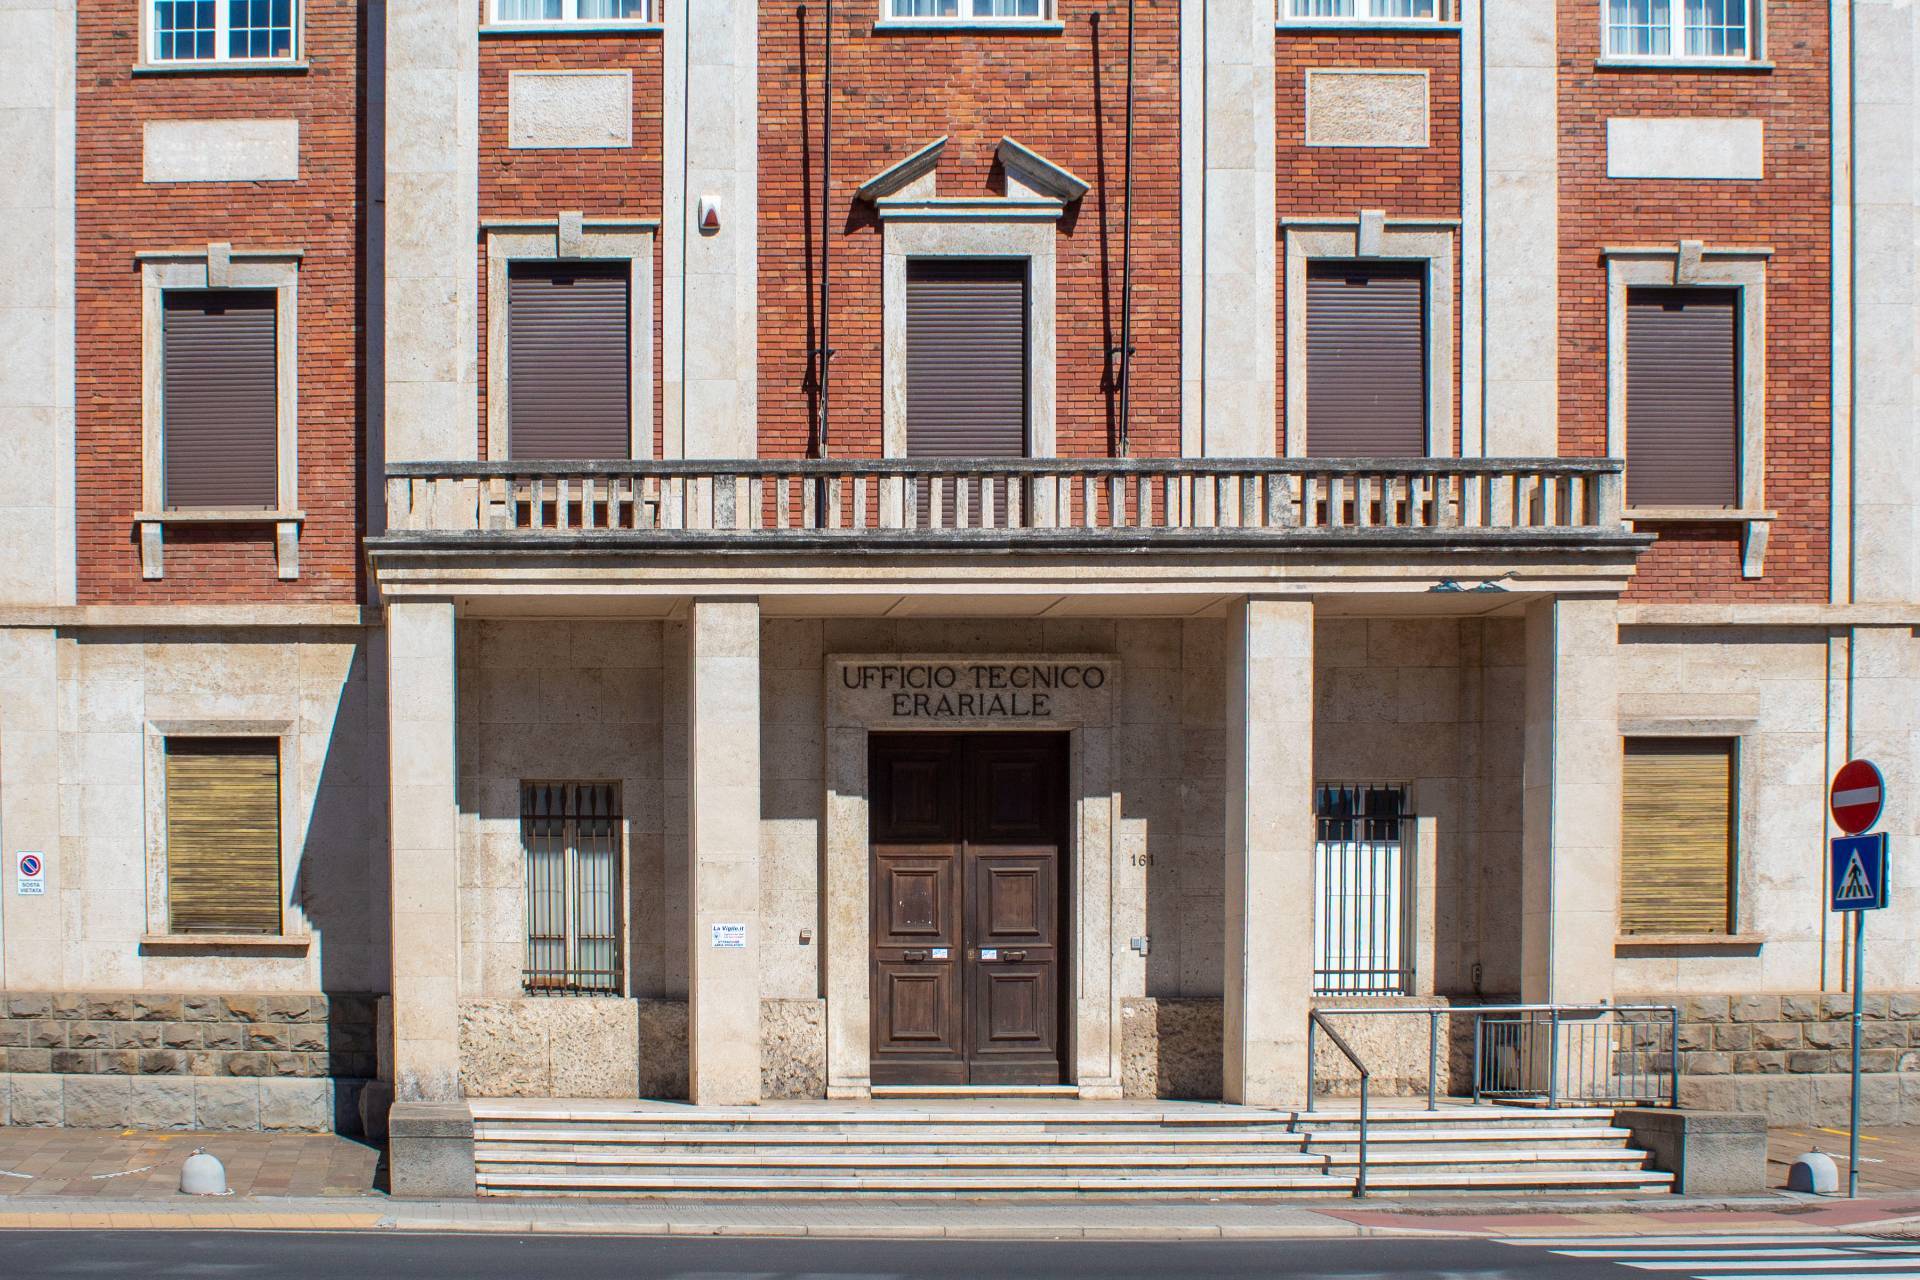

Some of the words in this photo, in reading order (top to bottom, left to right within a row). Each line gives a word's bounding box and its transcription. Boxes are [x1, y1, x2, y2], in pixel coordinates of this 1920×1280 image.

[842, 665, 956, 689] UFFICIO
[969, 665, 1105, 688] TECNICO
[892, 693, 1051, 716] ERARIALE
[1130, 854, 1154, 866] 161
